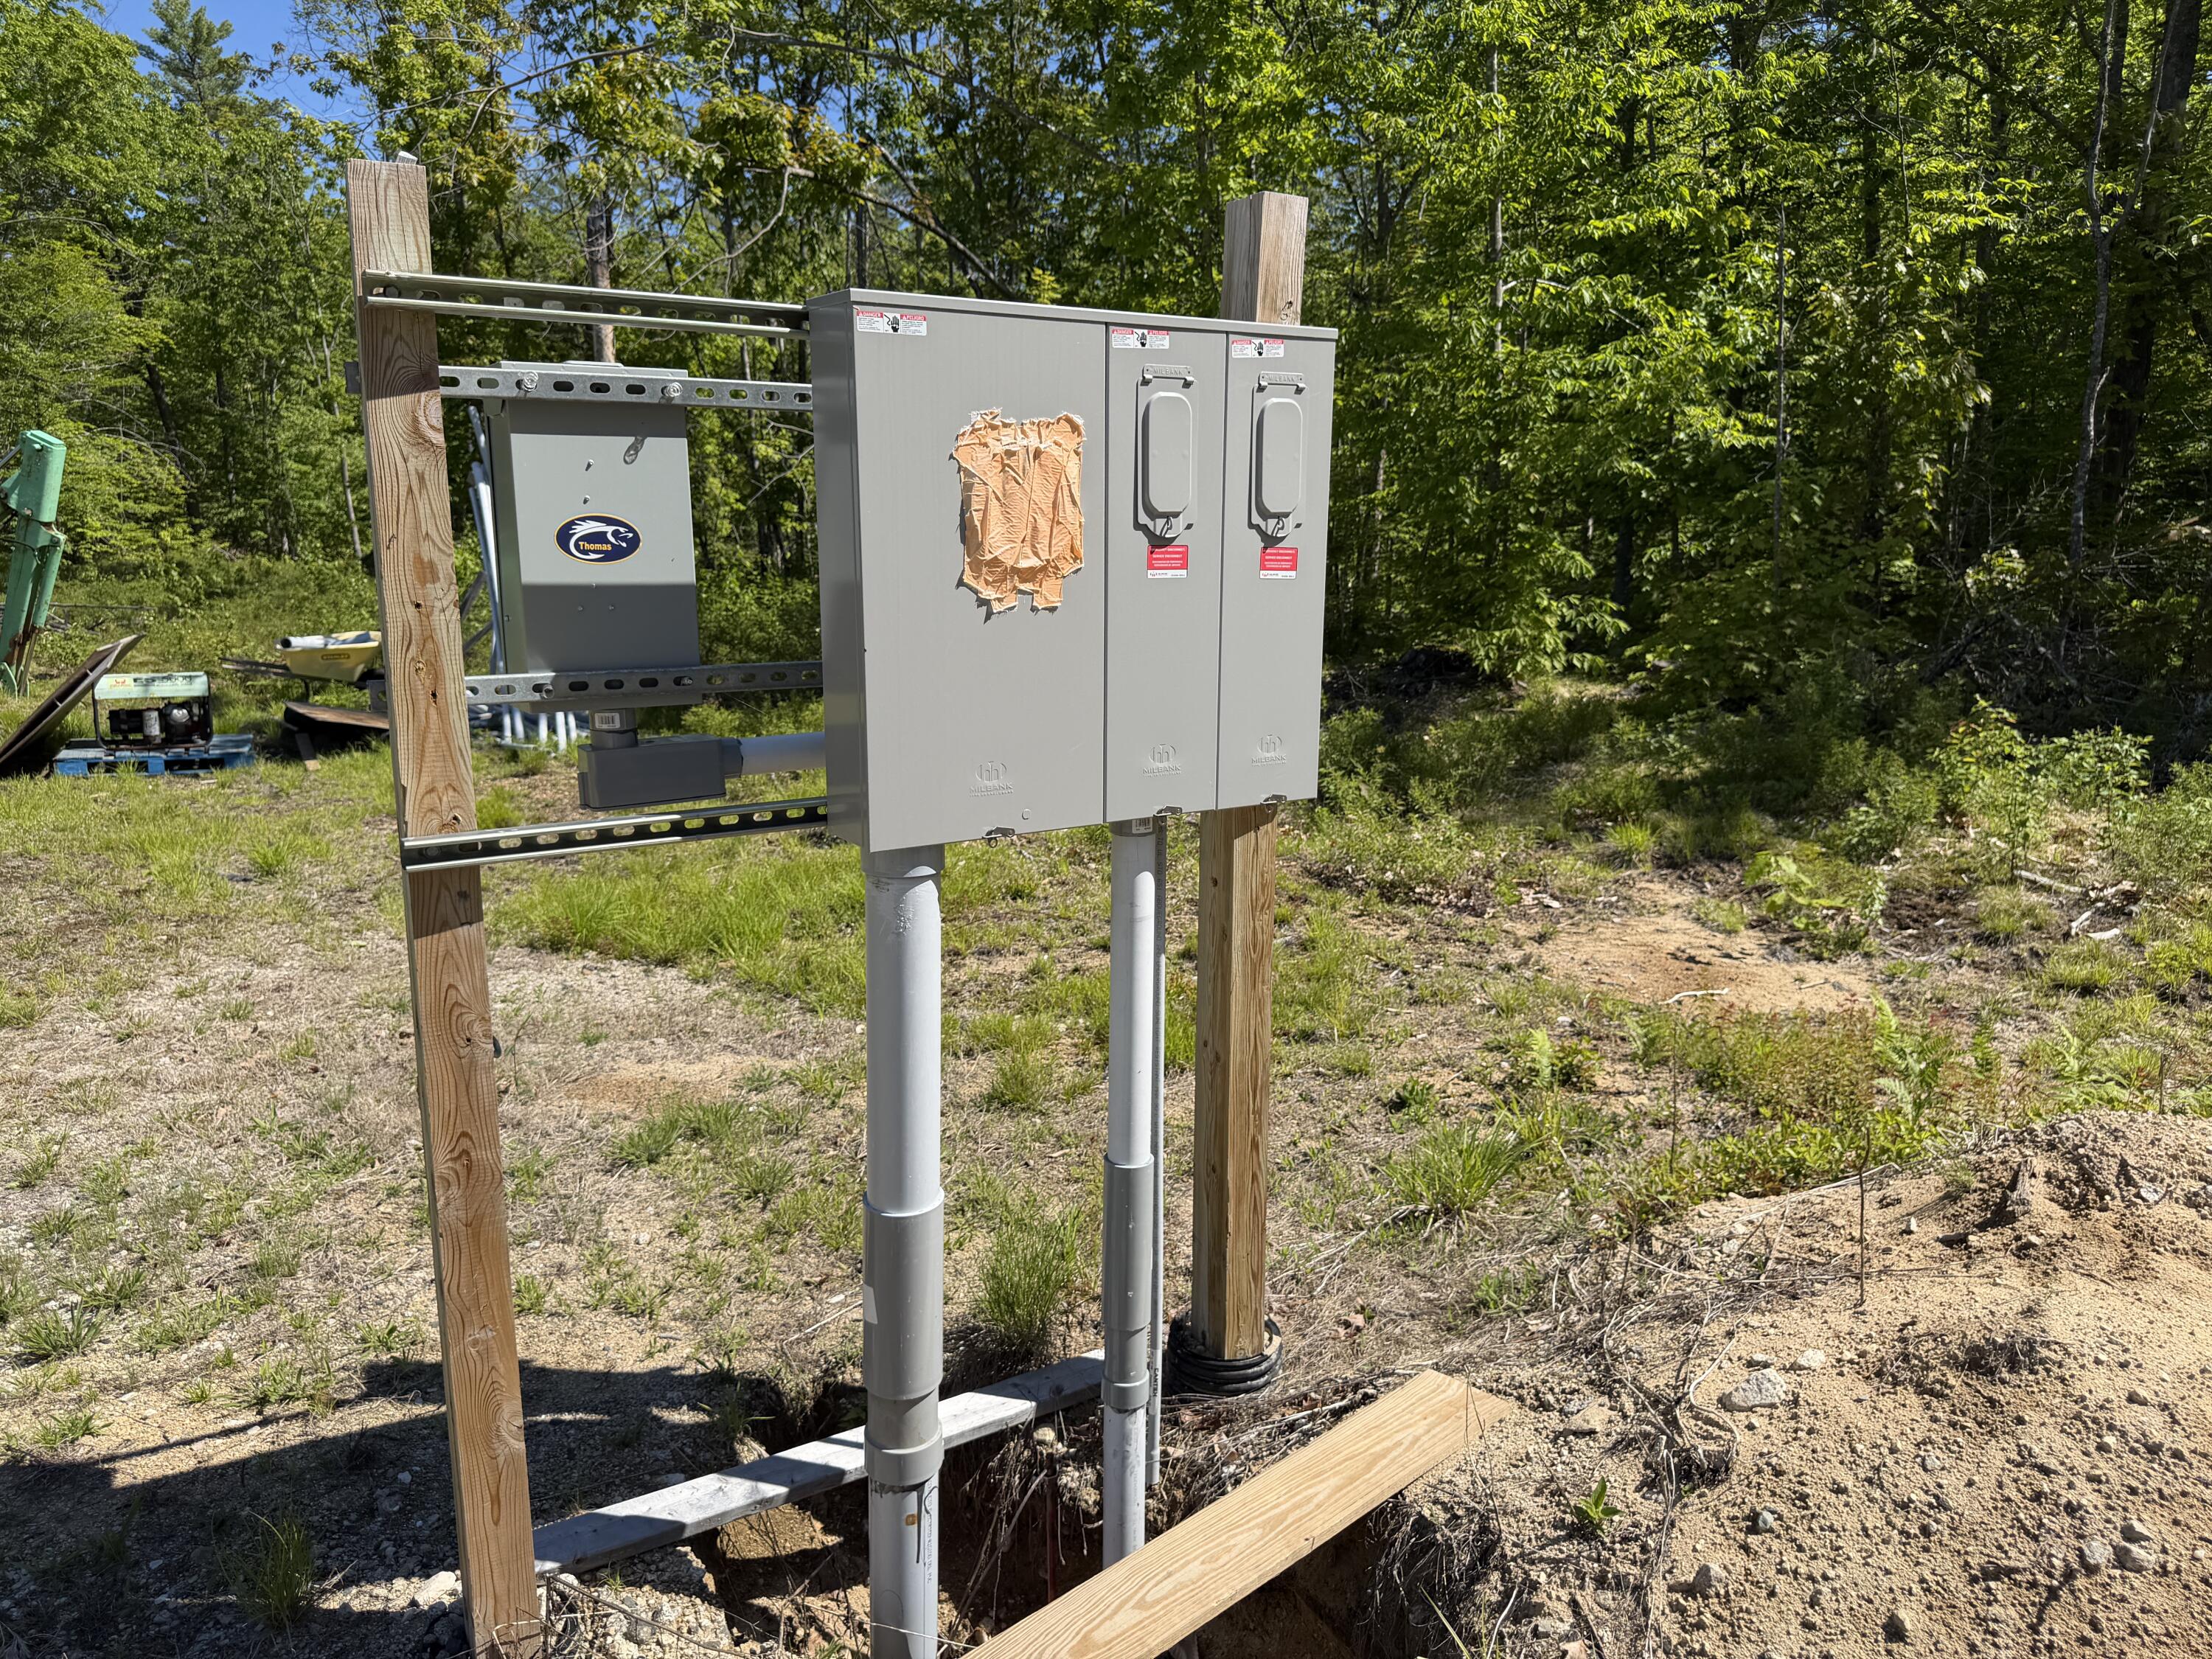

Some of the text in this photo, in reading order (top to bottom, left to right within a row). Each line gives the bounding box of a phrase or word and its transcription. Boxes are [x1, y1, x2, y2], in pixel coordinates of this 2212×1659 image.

[1153, 367, 1183, 375] MILBANK
[578, 541, 612, 551] Thomas
[1251, 754, 1287, 763] MILBANK
[1142, 764, 1180, 773] MILBANK
[969, 782, 1014, 793] MILBANK
